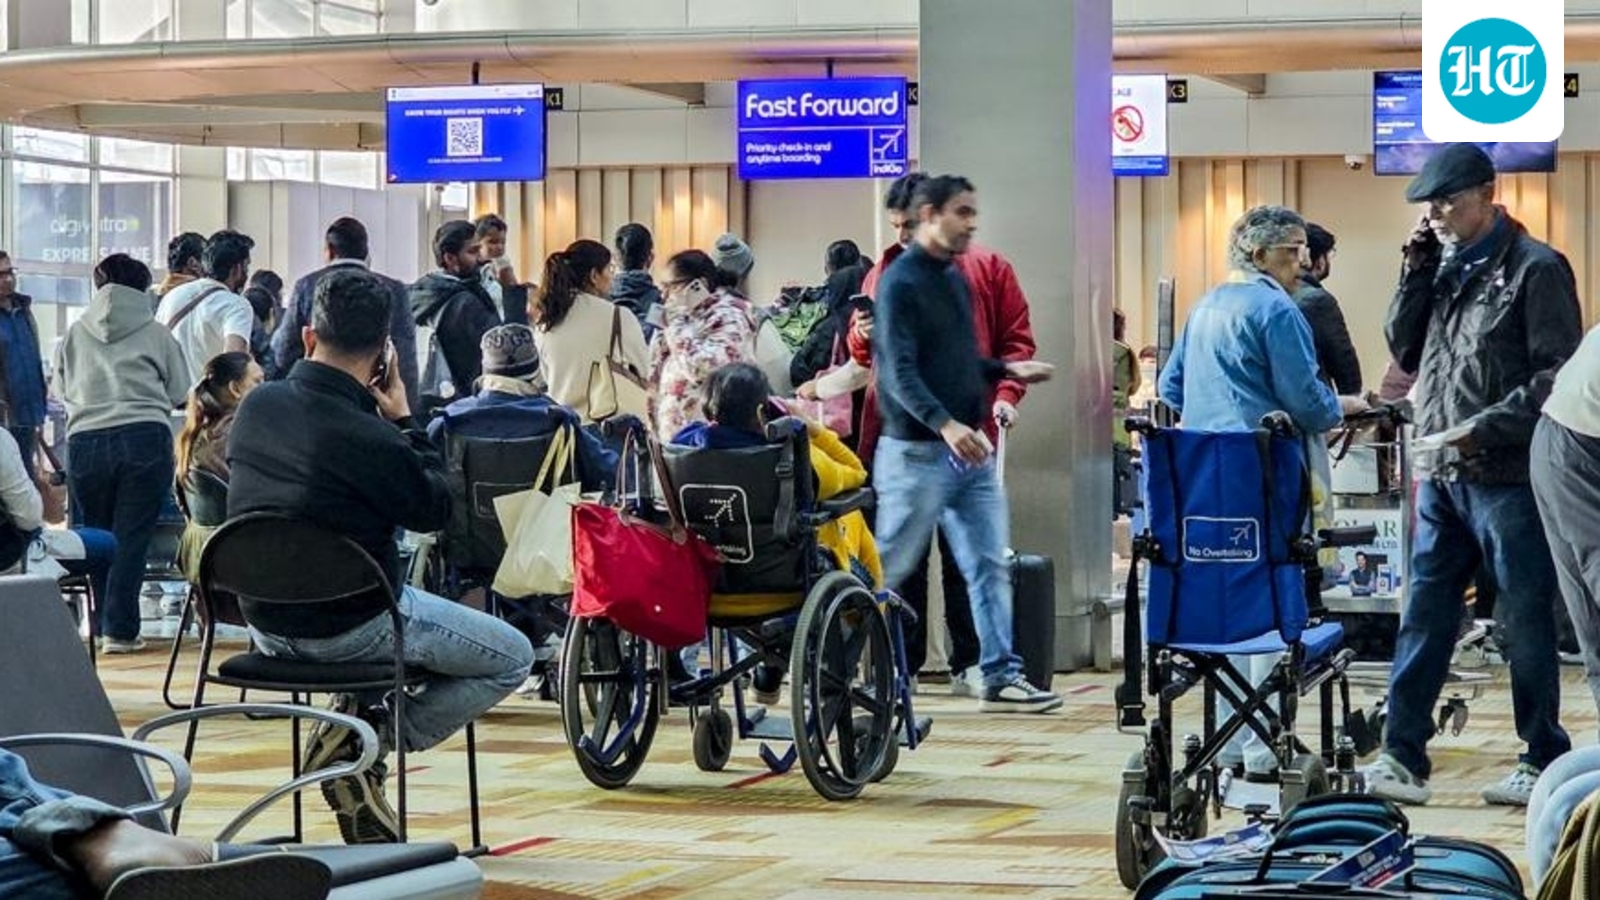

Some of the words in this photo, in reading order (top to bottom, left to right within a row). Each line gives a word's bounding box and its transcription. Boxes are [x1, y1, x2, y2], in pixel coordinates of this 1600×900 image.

[1564, 78, 1577, 93] 4
[545, 93, 561, 106] K1
[813, 141, 832, 151] and
[782, 153, 822, 165] boarding
[1188, 546, 1201, 557] No
[1202, 547, 1253, 558] Overtaking
